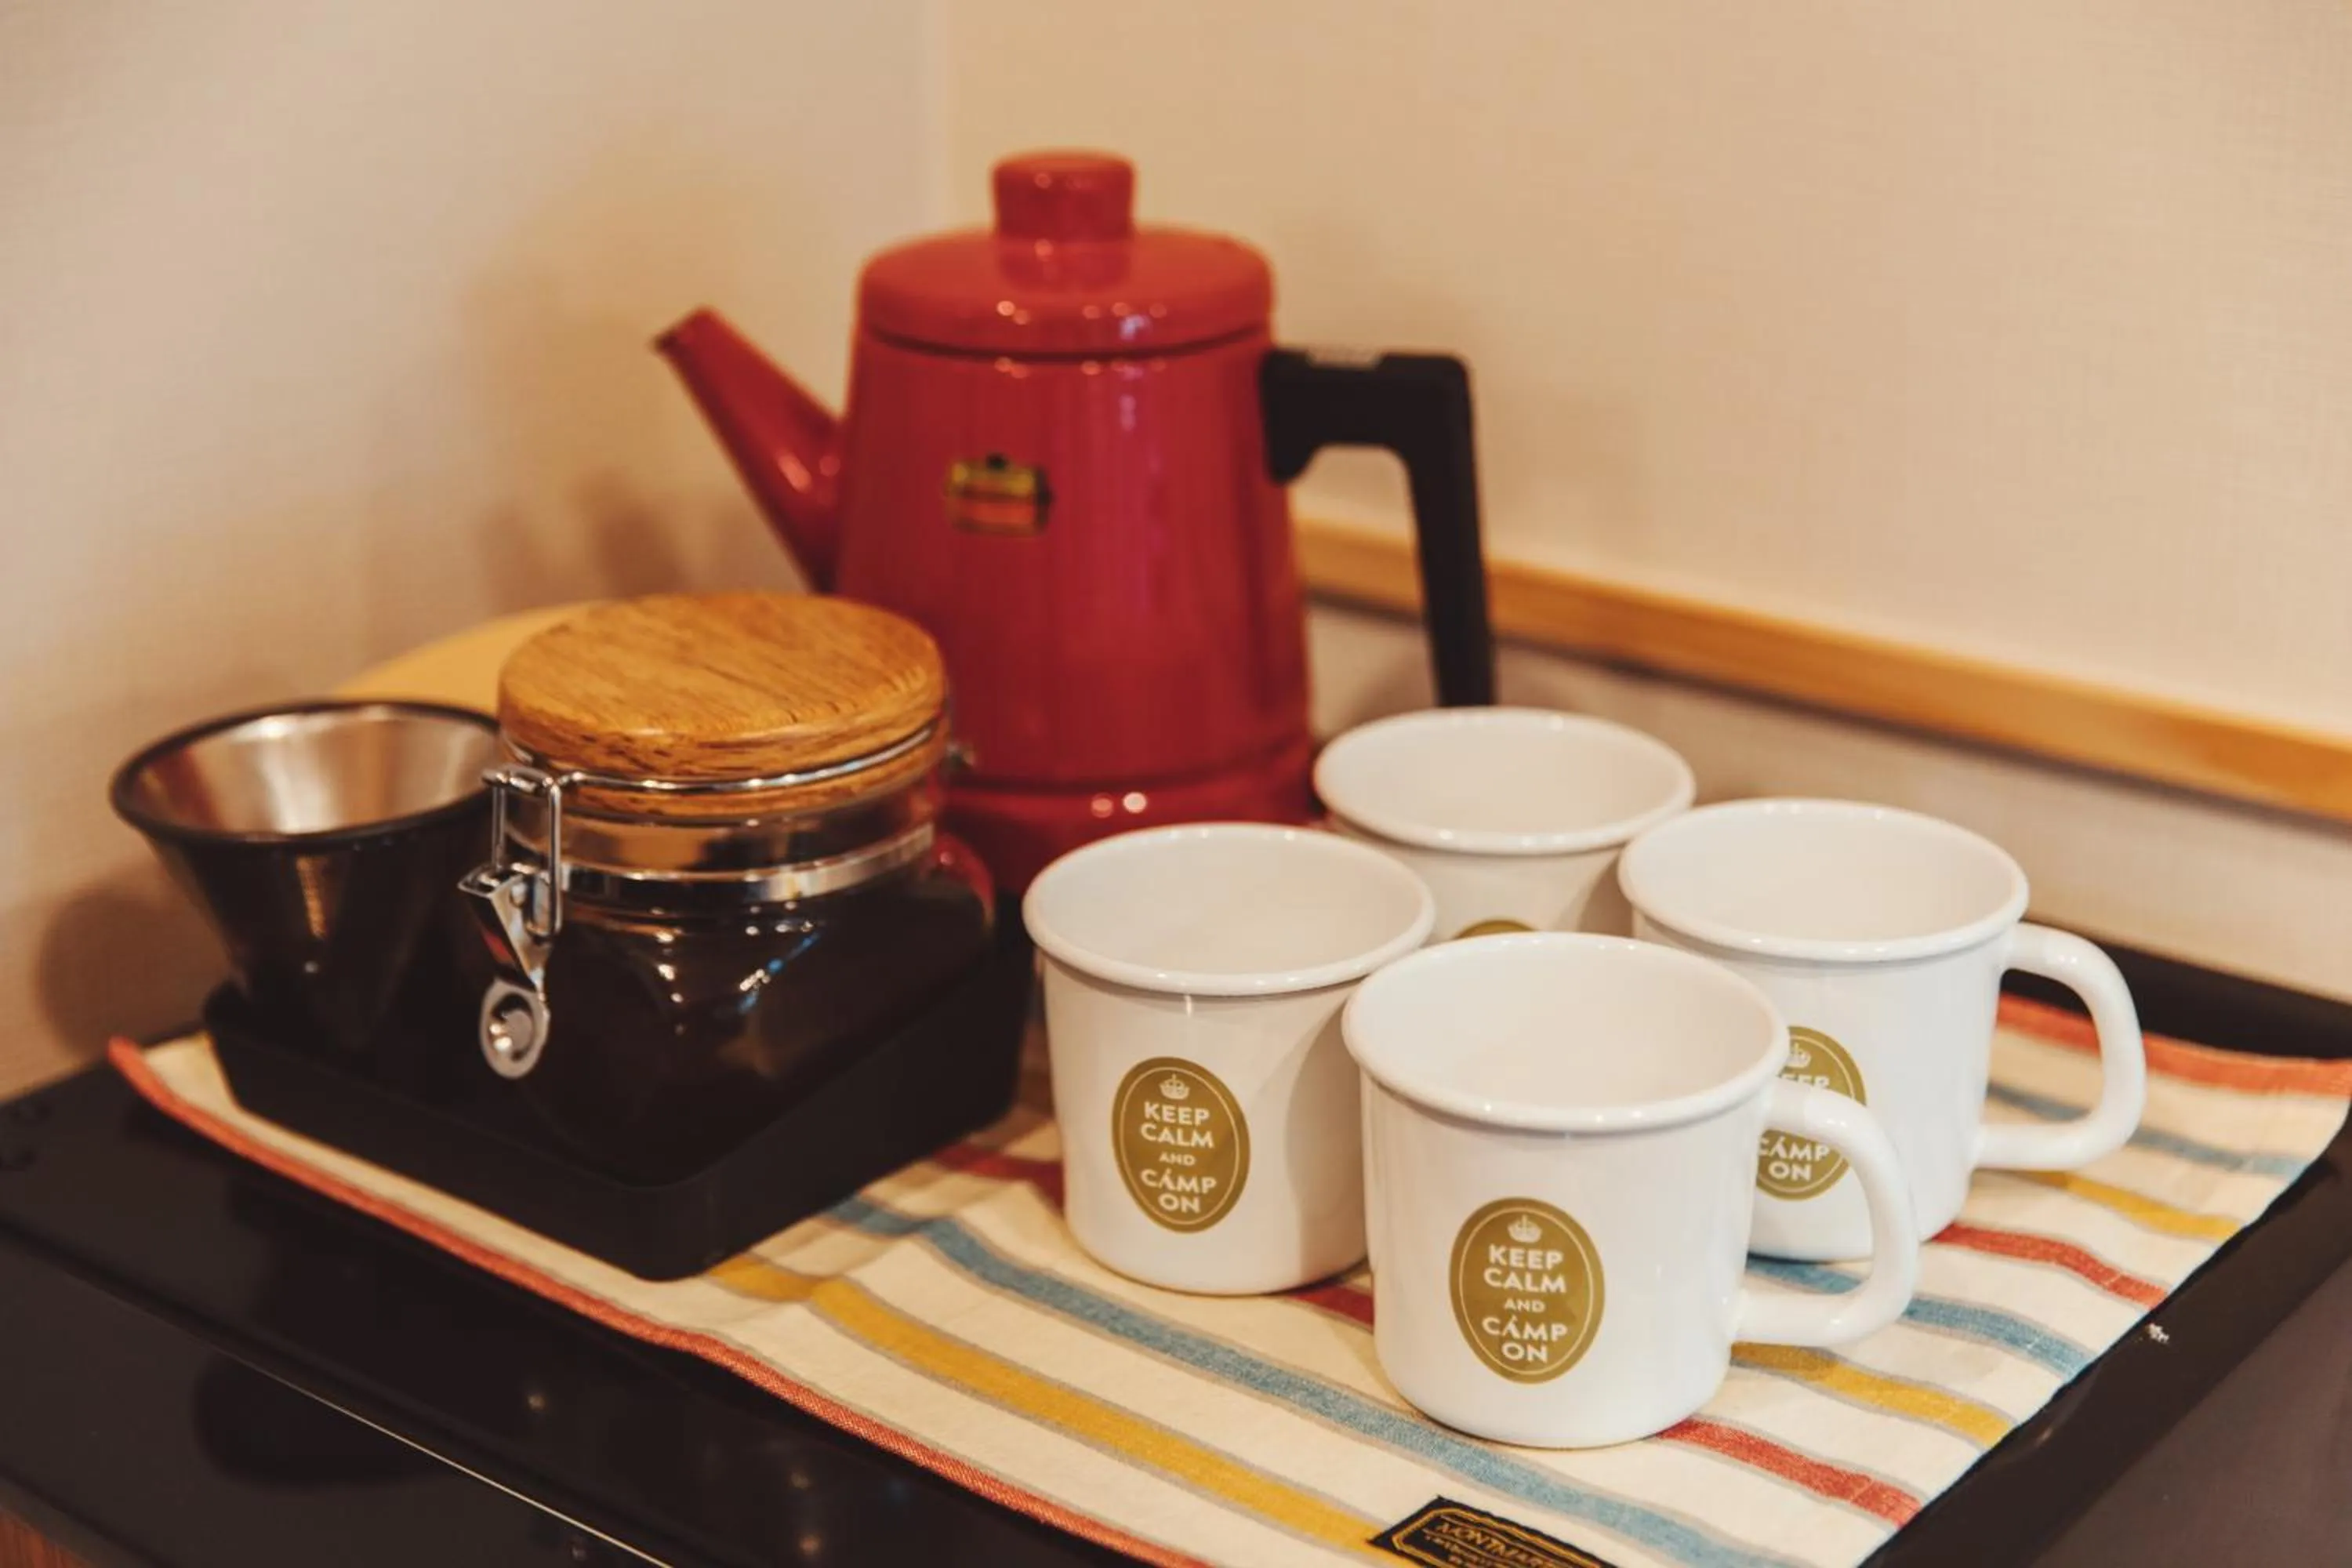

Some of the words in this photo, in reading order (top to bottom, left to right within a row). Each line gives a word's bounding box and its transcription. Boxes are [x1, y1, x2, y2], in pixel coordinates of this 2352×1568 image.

[1145, 1102, 1210, 1126] KEEP
[1141, 1123, 1214, 1148] CALM
[1160, 1151, 1196, 1166] AND
[1769, 1162, 1811, 1181] ON
[1158, 1193, 1200, 1213] ON
[1489, 1243, 1563, 1270] KEEP
[1483, 1268, 1566, 1294] CALM
[1504, 1298, 1544, 1312] AND
[1501, 1342, 1547, 1363] ON
